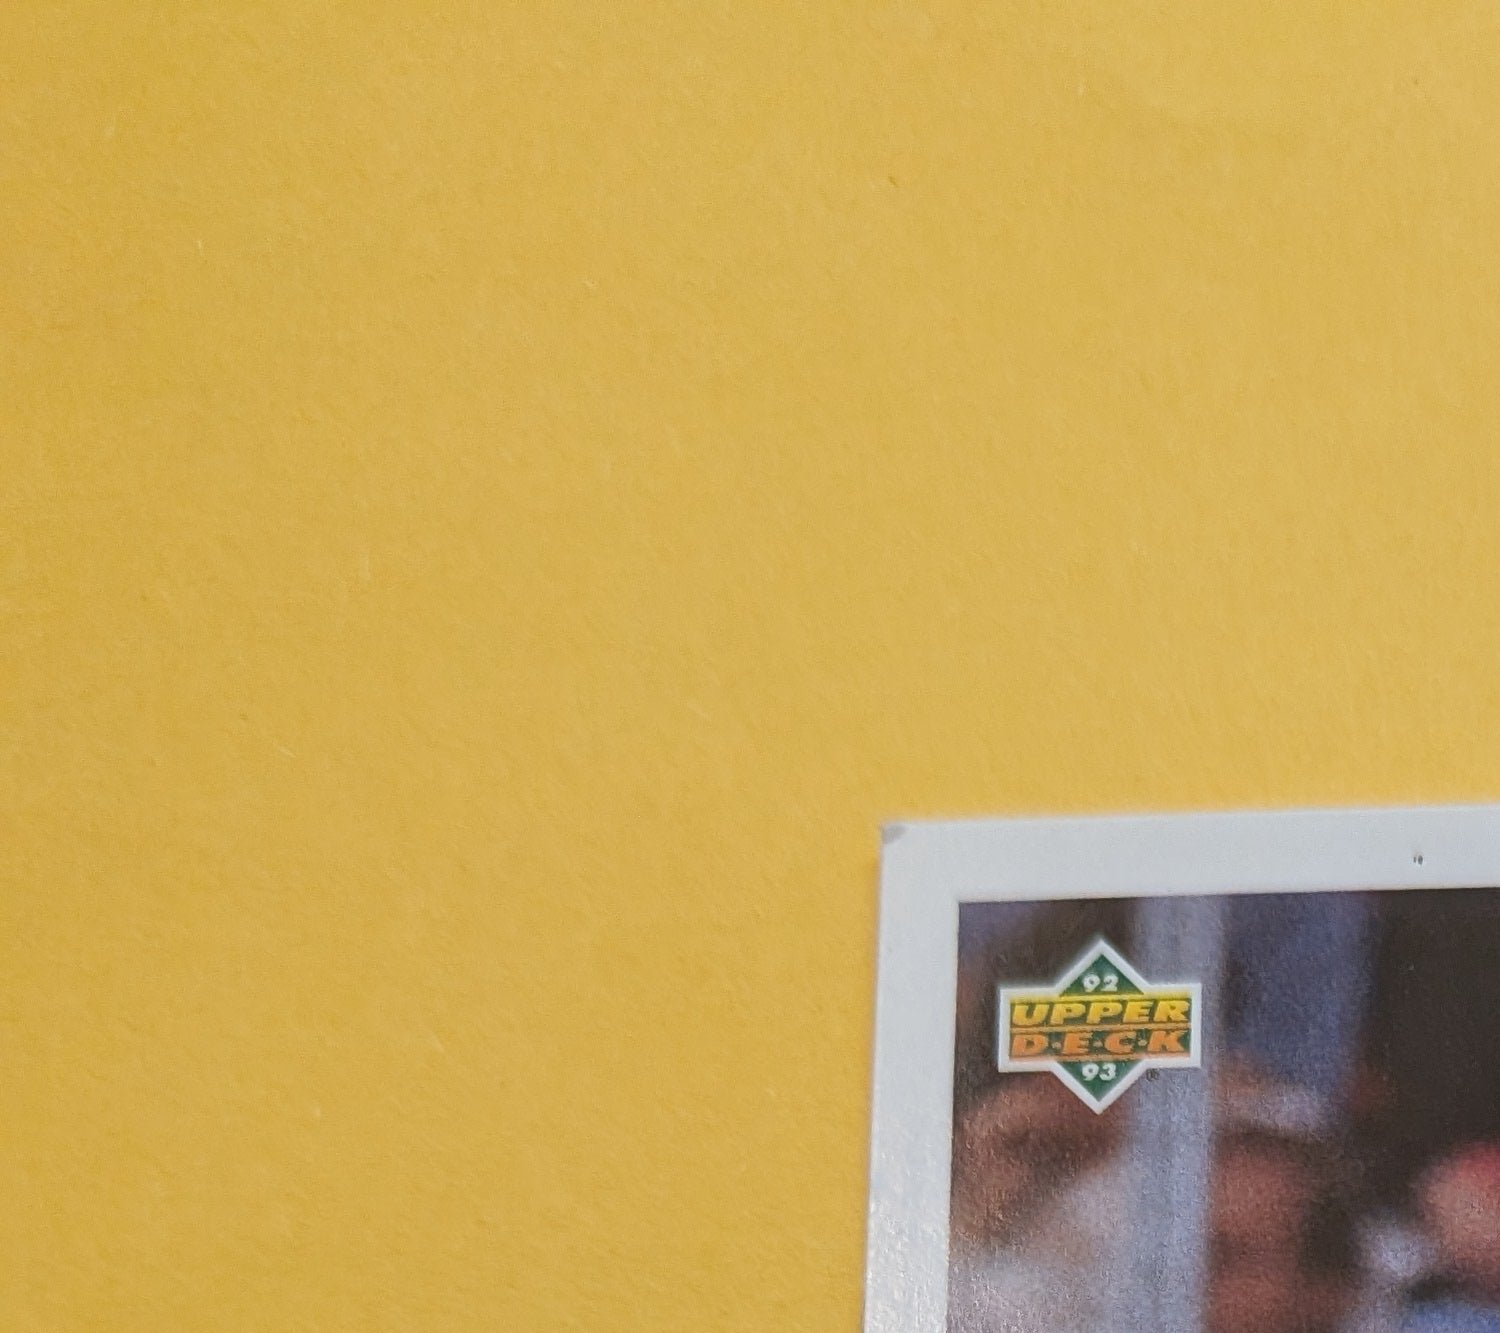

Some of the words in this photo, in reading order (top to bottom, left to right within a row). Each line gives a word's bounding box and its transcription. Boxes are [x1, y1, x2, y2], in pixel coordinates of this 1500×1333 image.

[1082, 973, 1120, 992] 92
[1012, 1000, 1191, 1026] UPPER
[1080, 1063, 1118, 1082] 93
